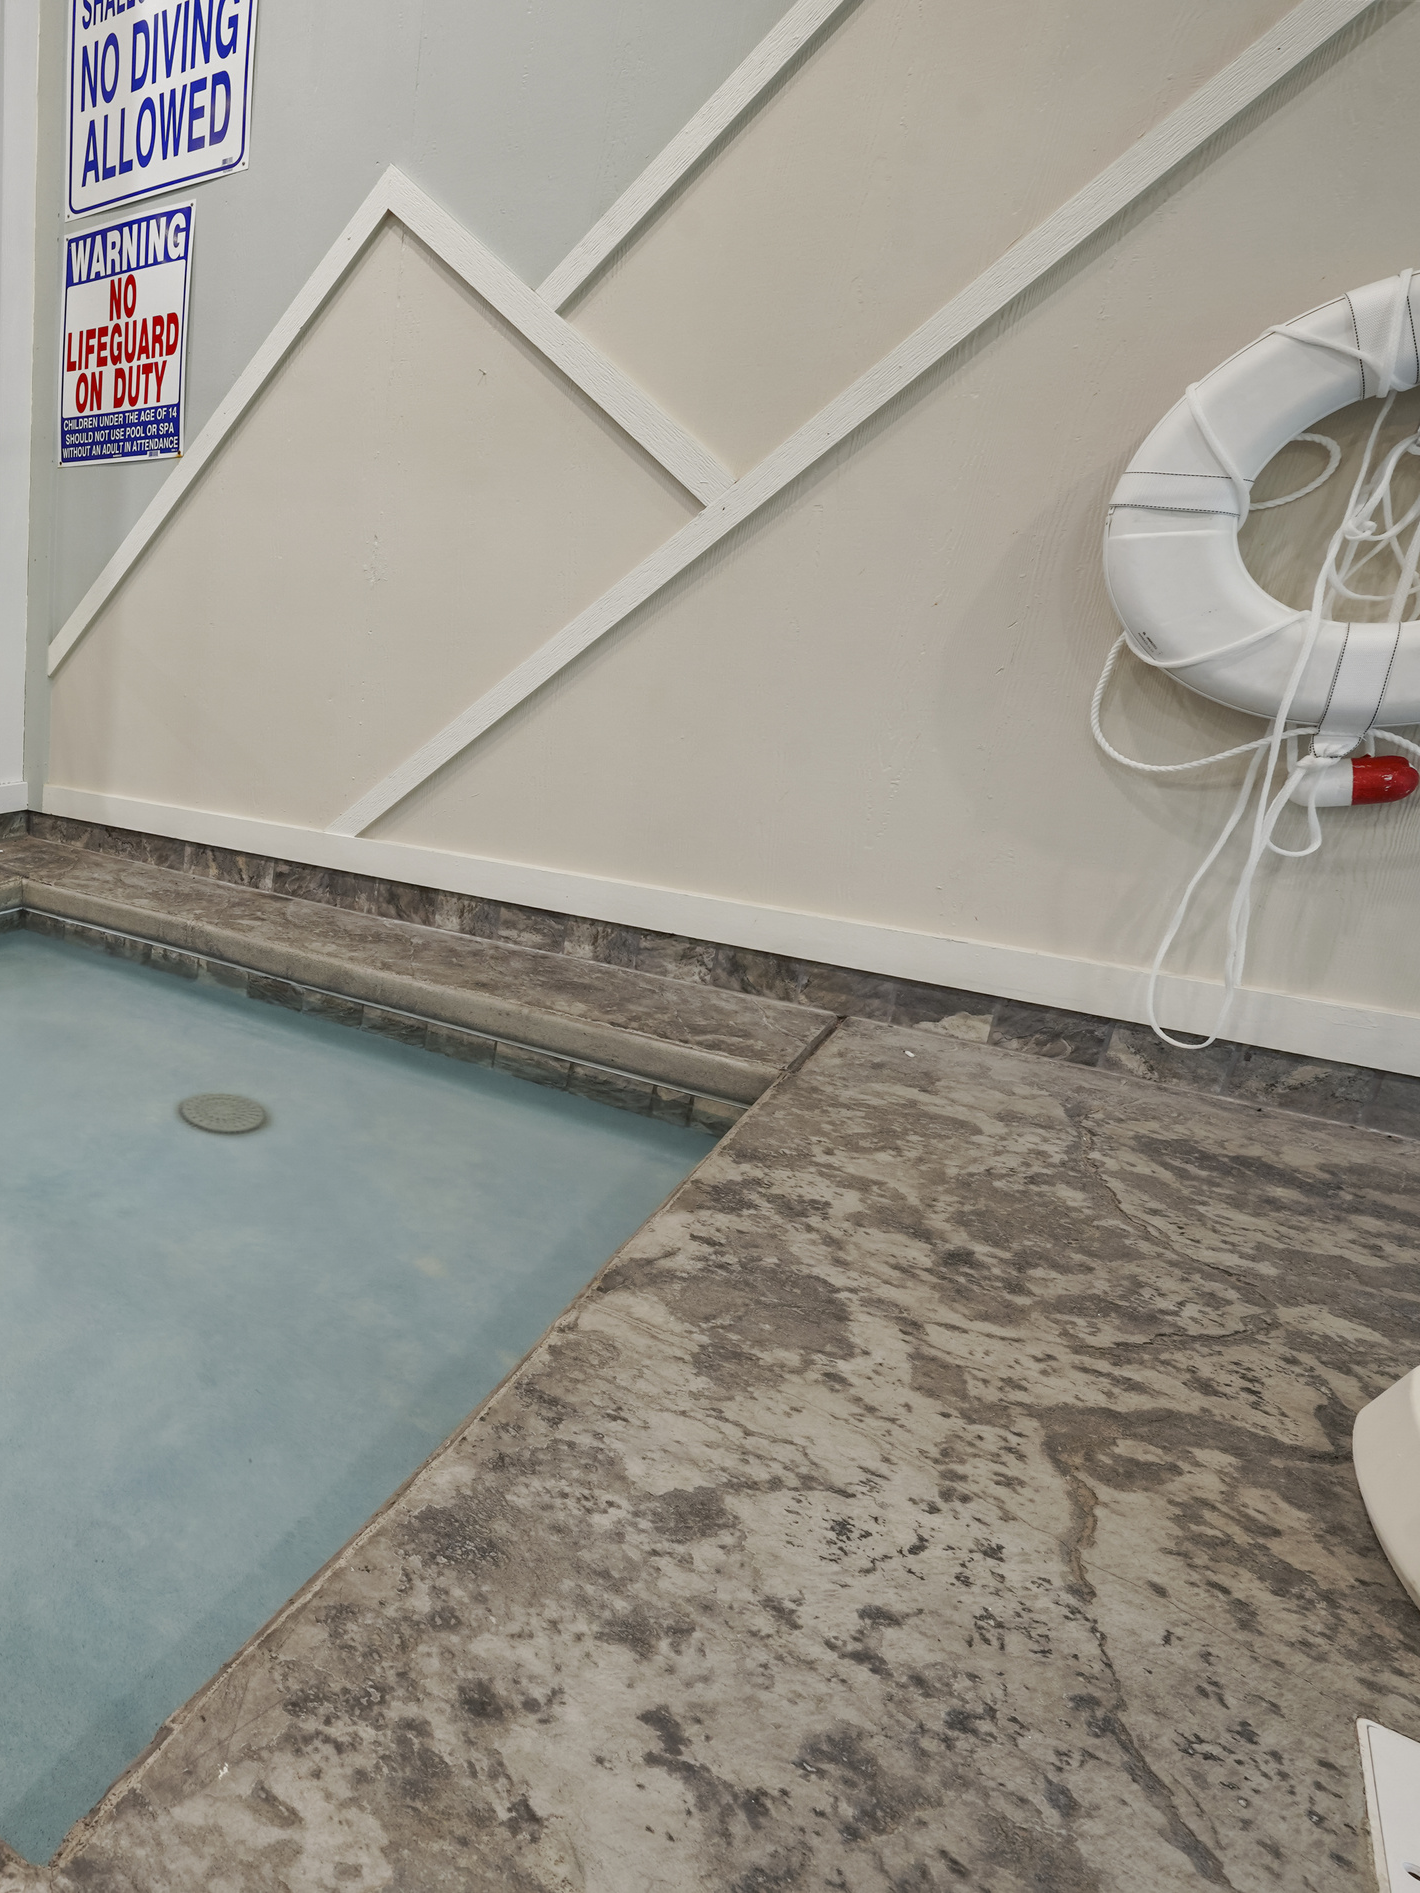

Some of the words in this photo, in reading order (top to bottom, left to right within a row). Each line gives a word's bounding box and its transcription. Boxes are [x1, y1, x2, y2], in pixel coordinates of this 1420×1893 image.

[80, 32, 120, 112] NO
[131, 0, 240, 93] DIVING
[81, 70, 232, 187] ALLOWED
[70, 212, 187, 284] WARNING
[109, 274, 137, 321] NO
[66, 312, 180, 372] LIFEGUARD
[75, 370, 103, 414] ON
[113, 360, 167, 409] DUTY
[63, 417, 98, 431] CHILDREN
[100, 414, 123, 427] UNDER
[125, 412, 139, 424] THE
[140, 409, 155, 422] AGE
[156, 407, 167, 420] OF
[168, 407, 177, 418] 14
[65, 432, 93, 445] SHOULD
[94, 430, 109, 442] NOT
[110, 428, 124, 440] USE
[125, 426, 145, 439] POOL
[146, 424, 157, 436] OR
[159, 422, 174, 435] SPA
[62, 446, 90, 459] WITHOUT
[91, 443, 101, 456] AN
[101, 442, 123, 455] ADULT
[124, 441, 131, 453] IN
[132, 436, 178, 452] ATTENDANCE
